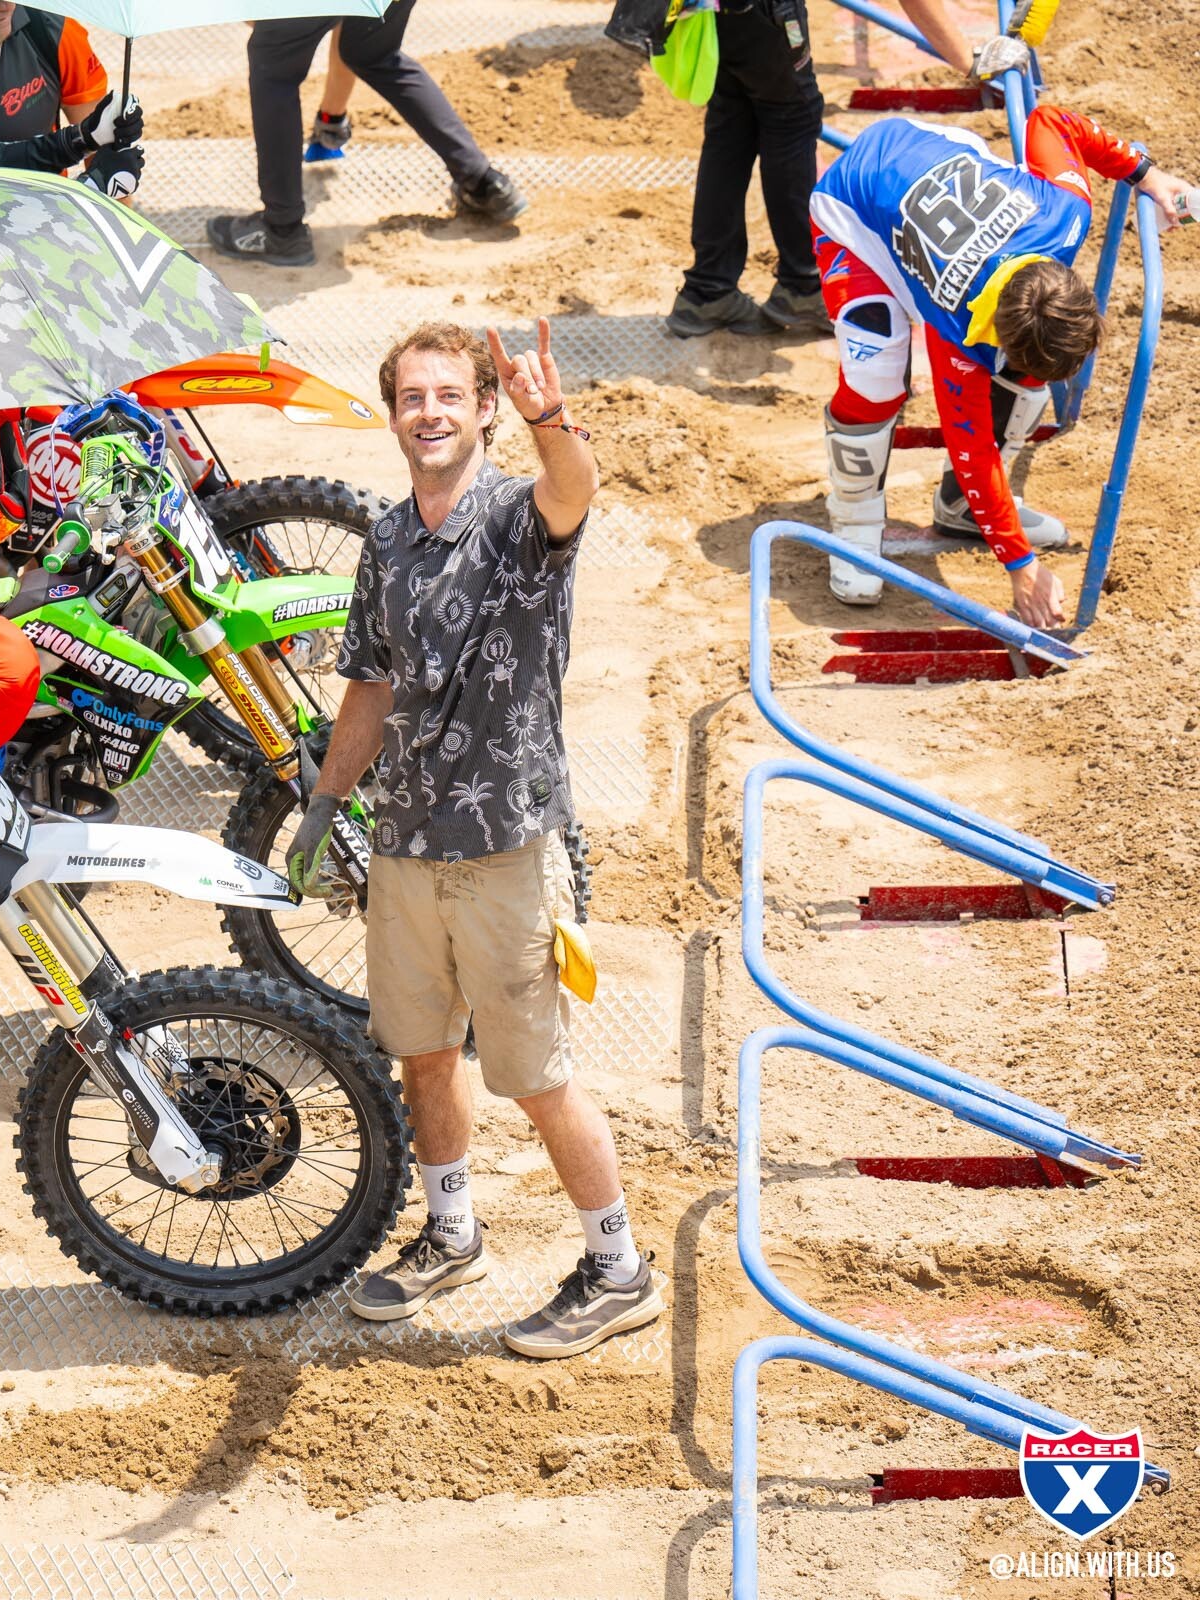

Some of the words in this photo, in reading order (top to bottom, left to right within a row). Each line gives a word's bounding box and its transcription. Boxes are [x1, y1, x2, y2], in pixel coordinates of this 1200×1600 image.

[936, 192, 1037, 310] MCDONNELL
[22, 619, 190, 706] #NOAHSTRONG
[226, 651, 253, 684] PRO
[248, 684, 294, 741] CIRCUIT
[92, 698, 164, 732] OnlyFans
[237, 692, 280, 747] SHOWA
[99, 733, 141, 755] #4KC
[66, 854, 147, 868] MOTORBIKES
[216, 879, 244, 891] CONLEY
[133, 1100, 155, 1128] CHAPPELL
[435, 1214, 466, 1226] FREE
